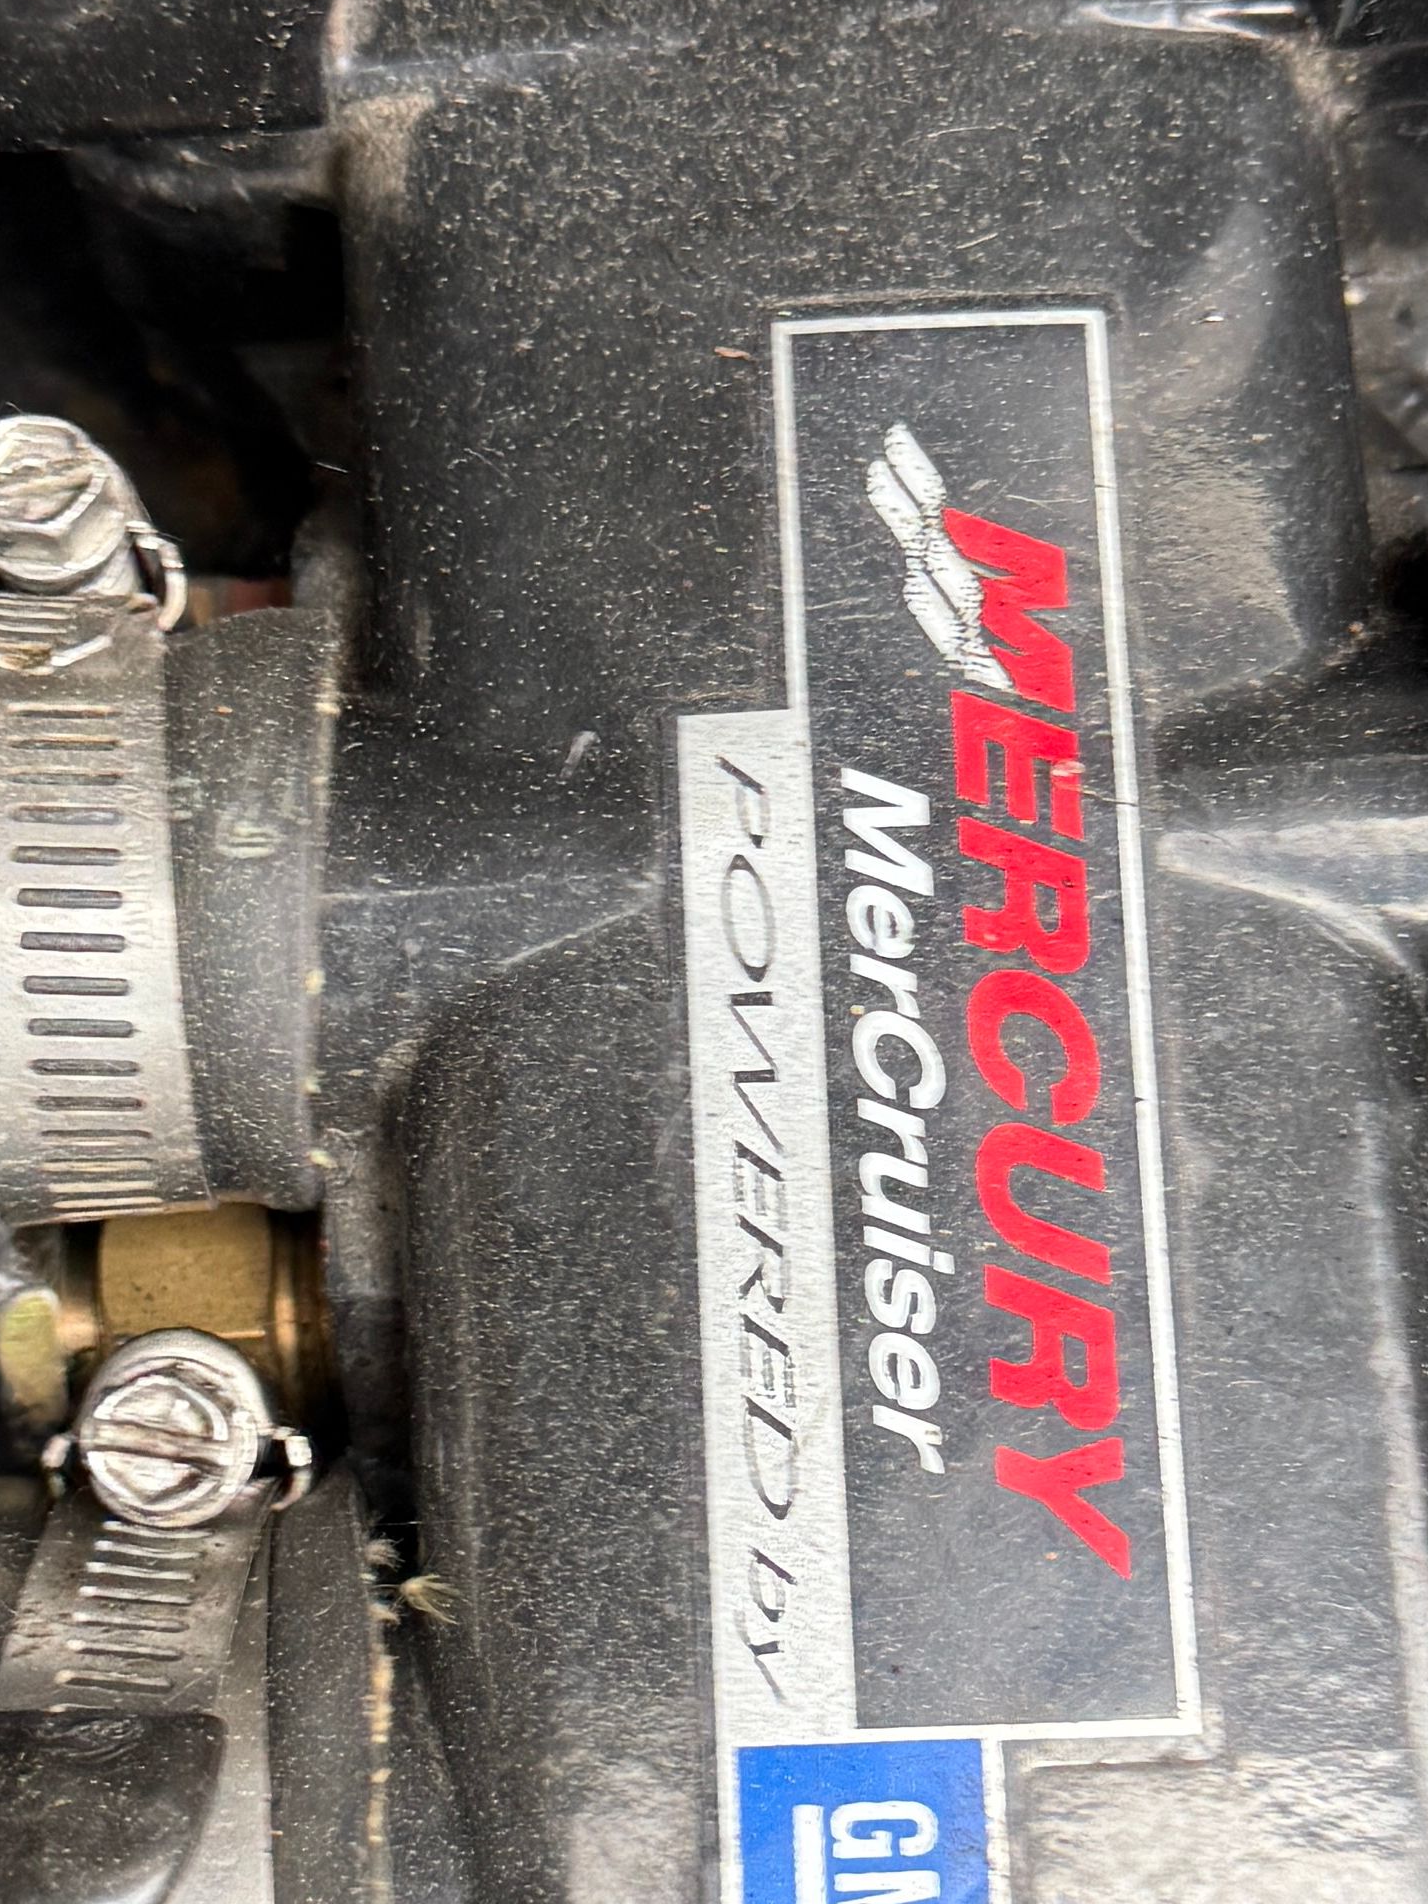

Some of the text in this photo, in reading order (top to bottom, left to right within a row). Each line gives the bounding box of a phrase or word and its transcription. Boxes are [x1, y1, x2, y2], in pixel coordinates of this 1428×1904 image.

[715, 754, 802, 1700] POWERED by
[840, 767, 956, 1475] MerCruiser
[941, 506, 1134, 1582] MERCURY
